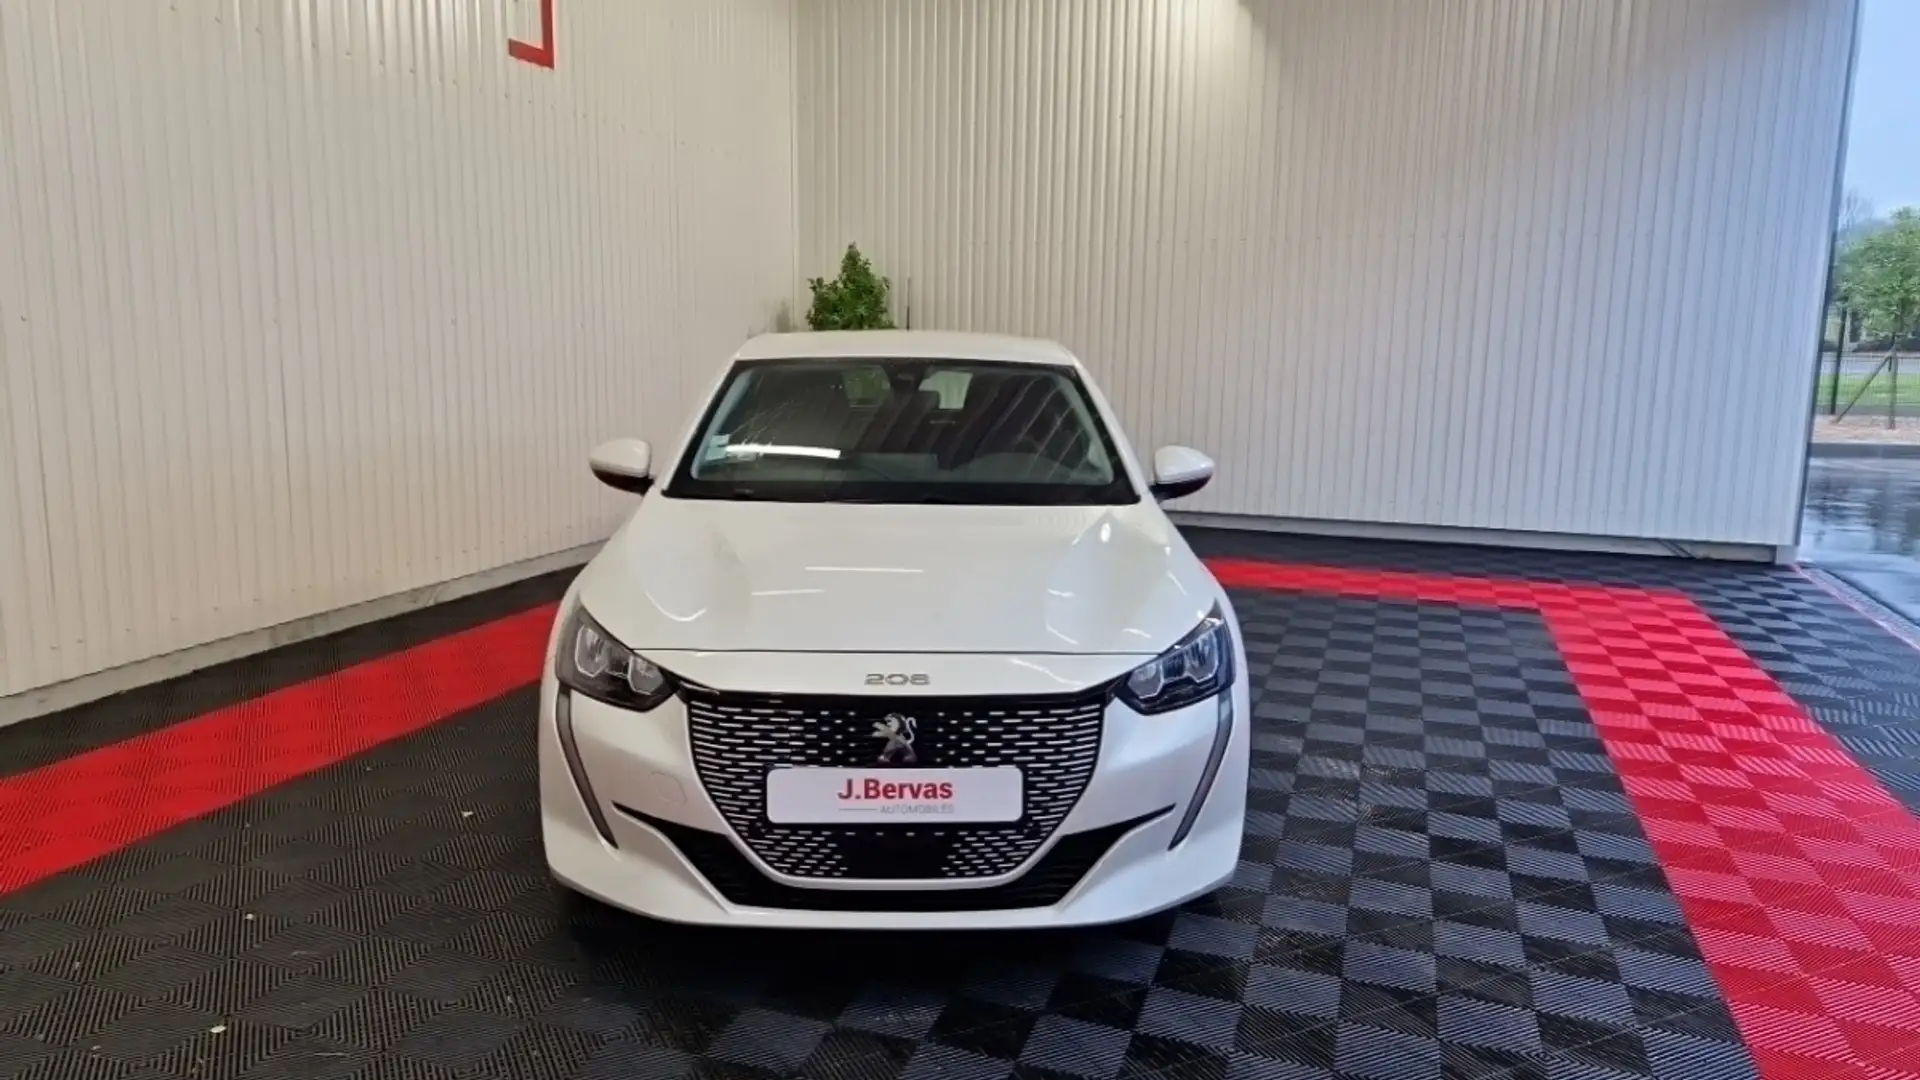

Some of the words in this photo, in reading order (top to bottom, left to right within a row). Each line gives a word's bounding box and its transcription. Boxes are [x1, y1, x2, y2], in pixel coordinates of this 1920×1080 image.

[864, 673, 931, 686] 208
[837, 778, 953, 800] J.Bervas
[880, 804, 955, 814] AUTOMOBILES
